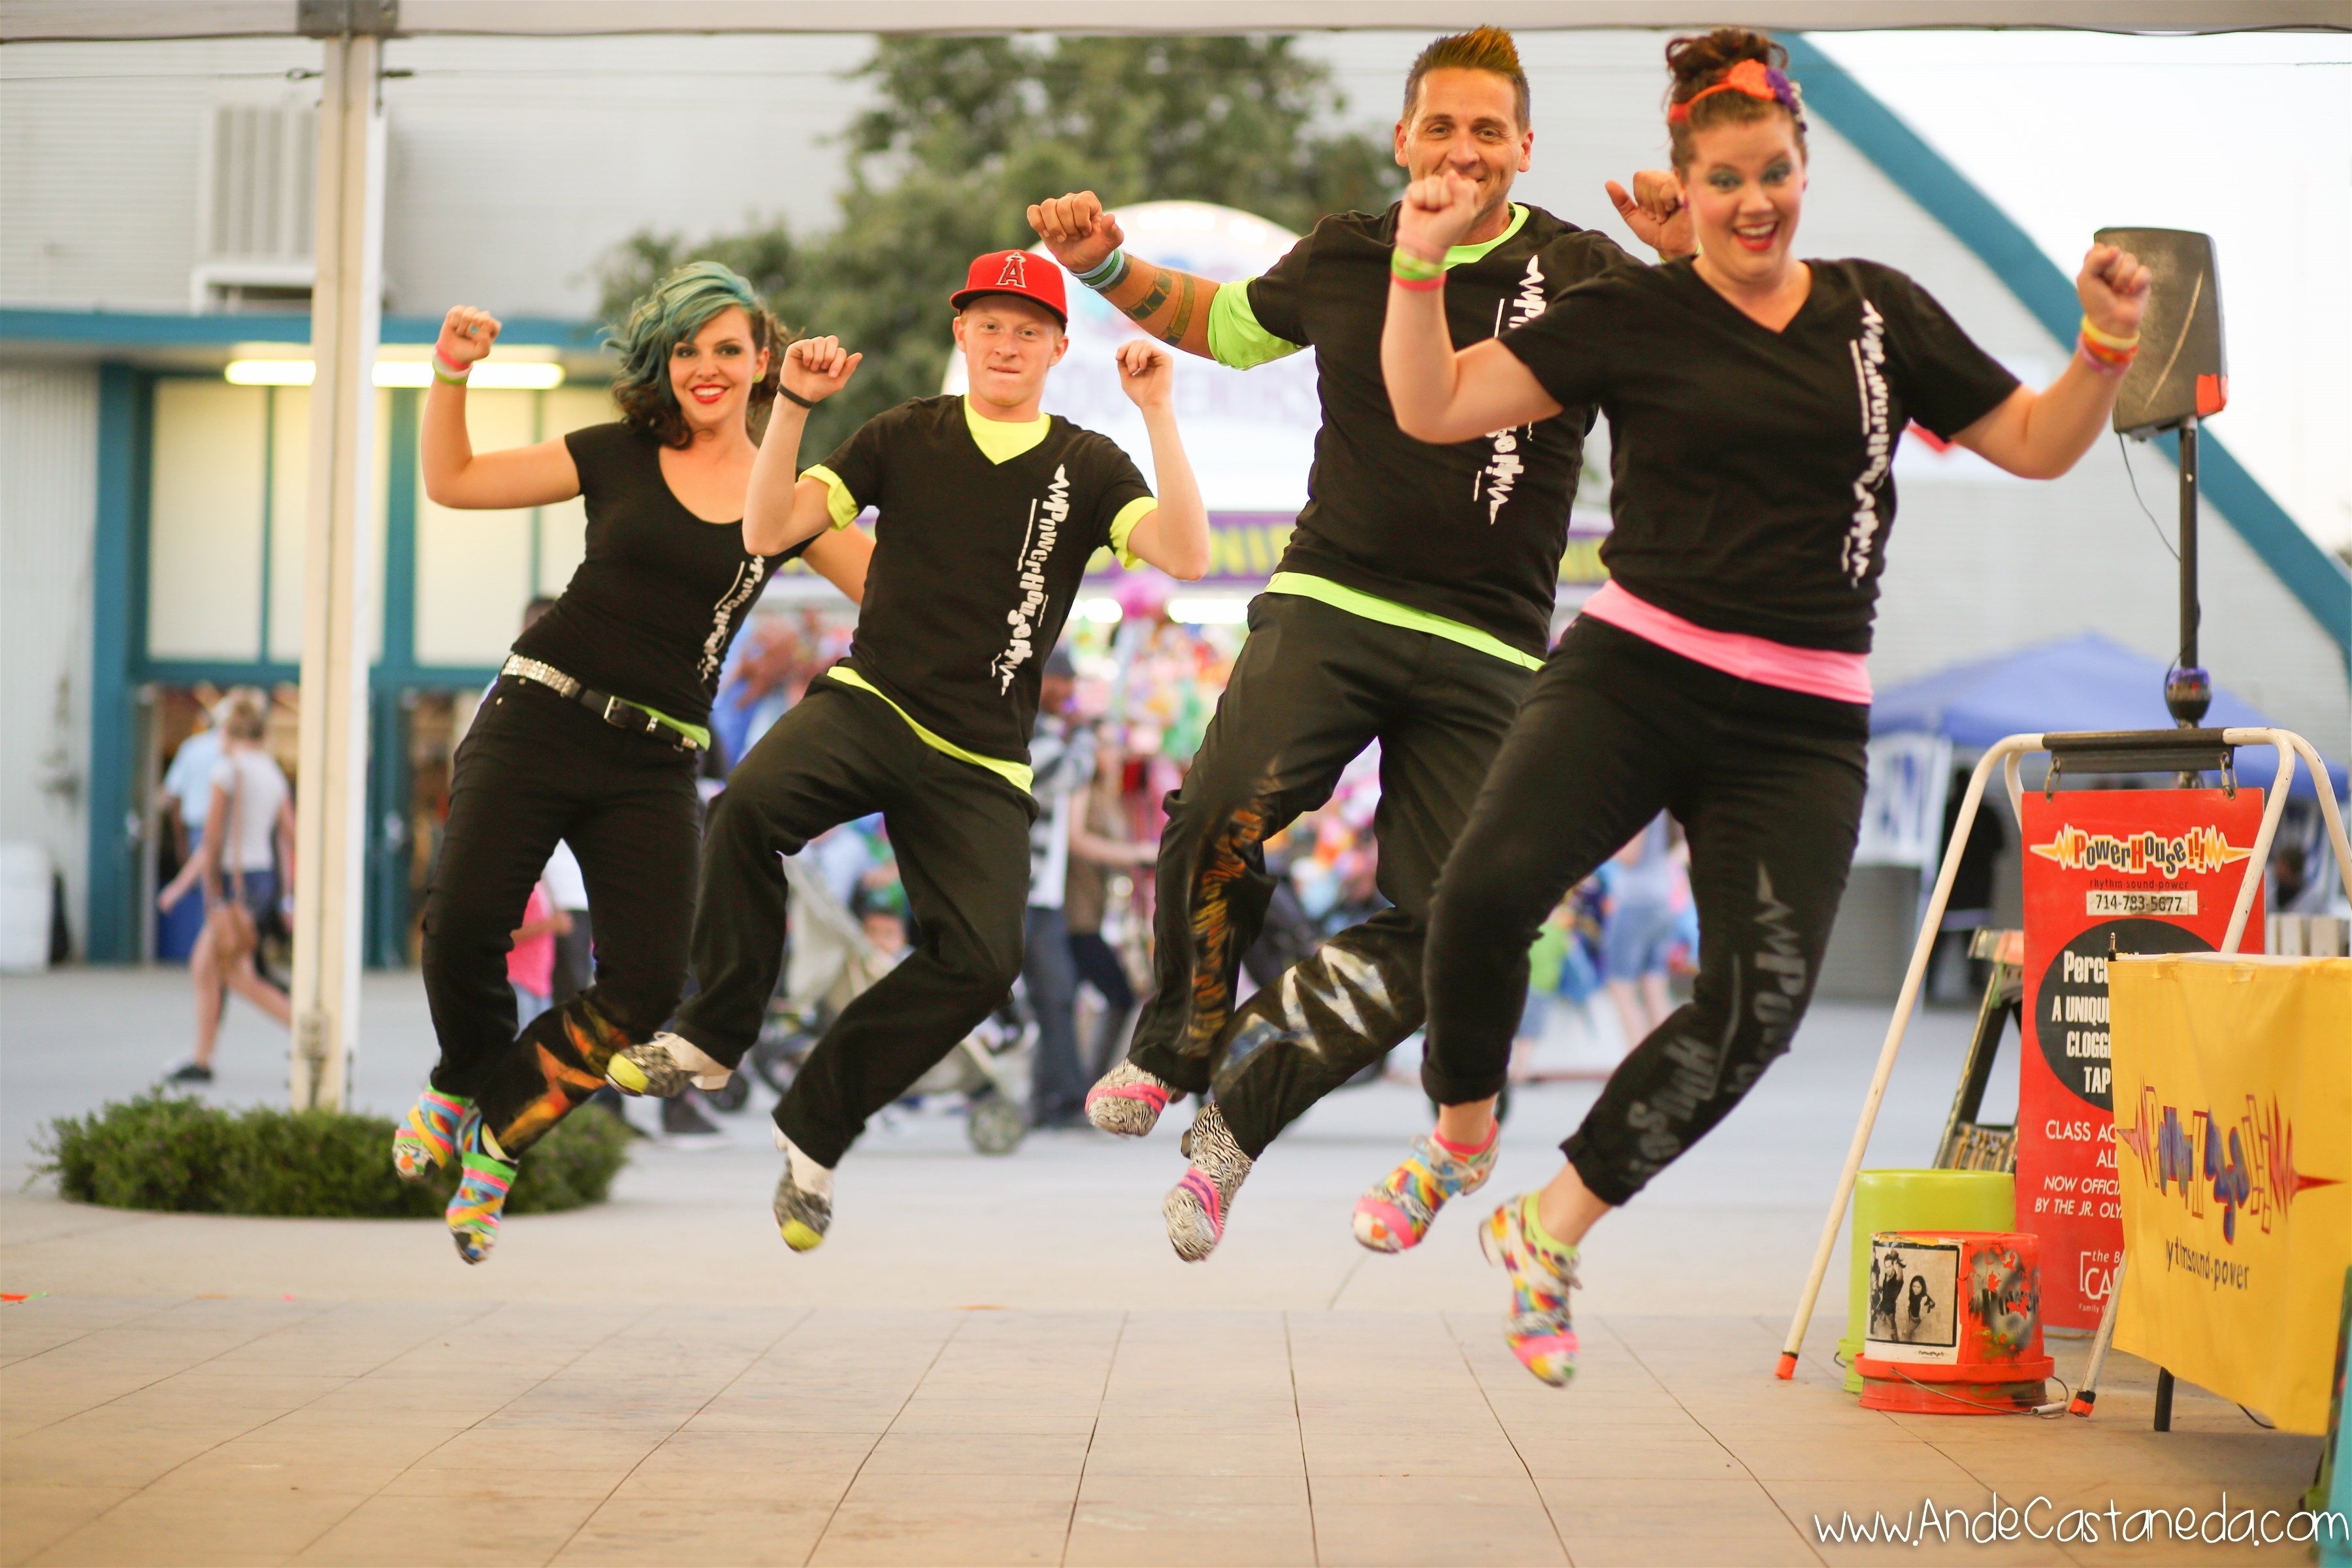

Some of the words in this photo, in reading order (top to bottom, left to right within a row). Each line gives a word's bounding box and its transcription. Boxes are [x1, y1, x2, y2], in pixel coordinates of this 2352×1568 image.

[996, 252, 1026, 288] A
[2072, 827, 2206, 875] PowerHouse!!!
[2091, 879, 2122, 890] rhythm
[2096, 894, 2182, 912] 714-783-5677
[2051, 995, 2062, 1022] A
[2084, 1066, 2111, 1094] TAP
[2046, 1119, 2091, 1142] CLASS
[2044, 1175, 2078, 1192] NOW
[2081, 1177, 2120, 1196] OFFICI
[2034, 1196, 2050, 1213] BY
[2054, 1198, 2075, 1215] THE
[2078, 1200, 2093, 1217] JR.
[2099, 1201, 2123, 1219] OLY
[2092, 1249, 2109, 1263] the
[2079, 1303, 2100, 1314] Family
